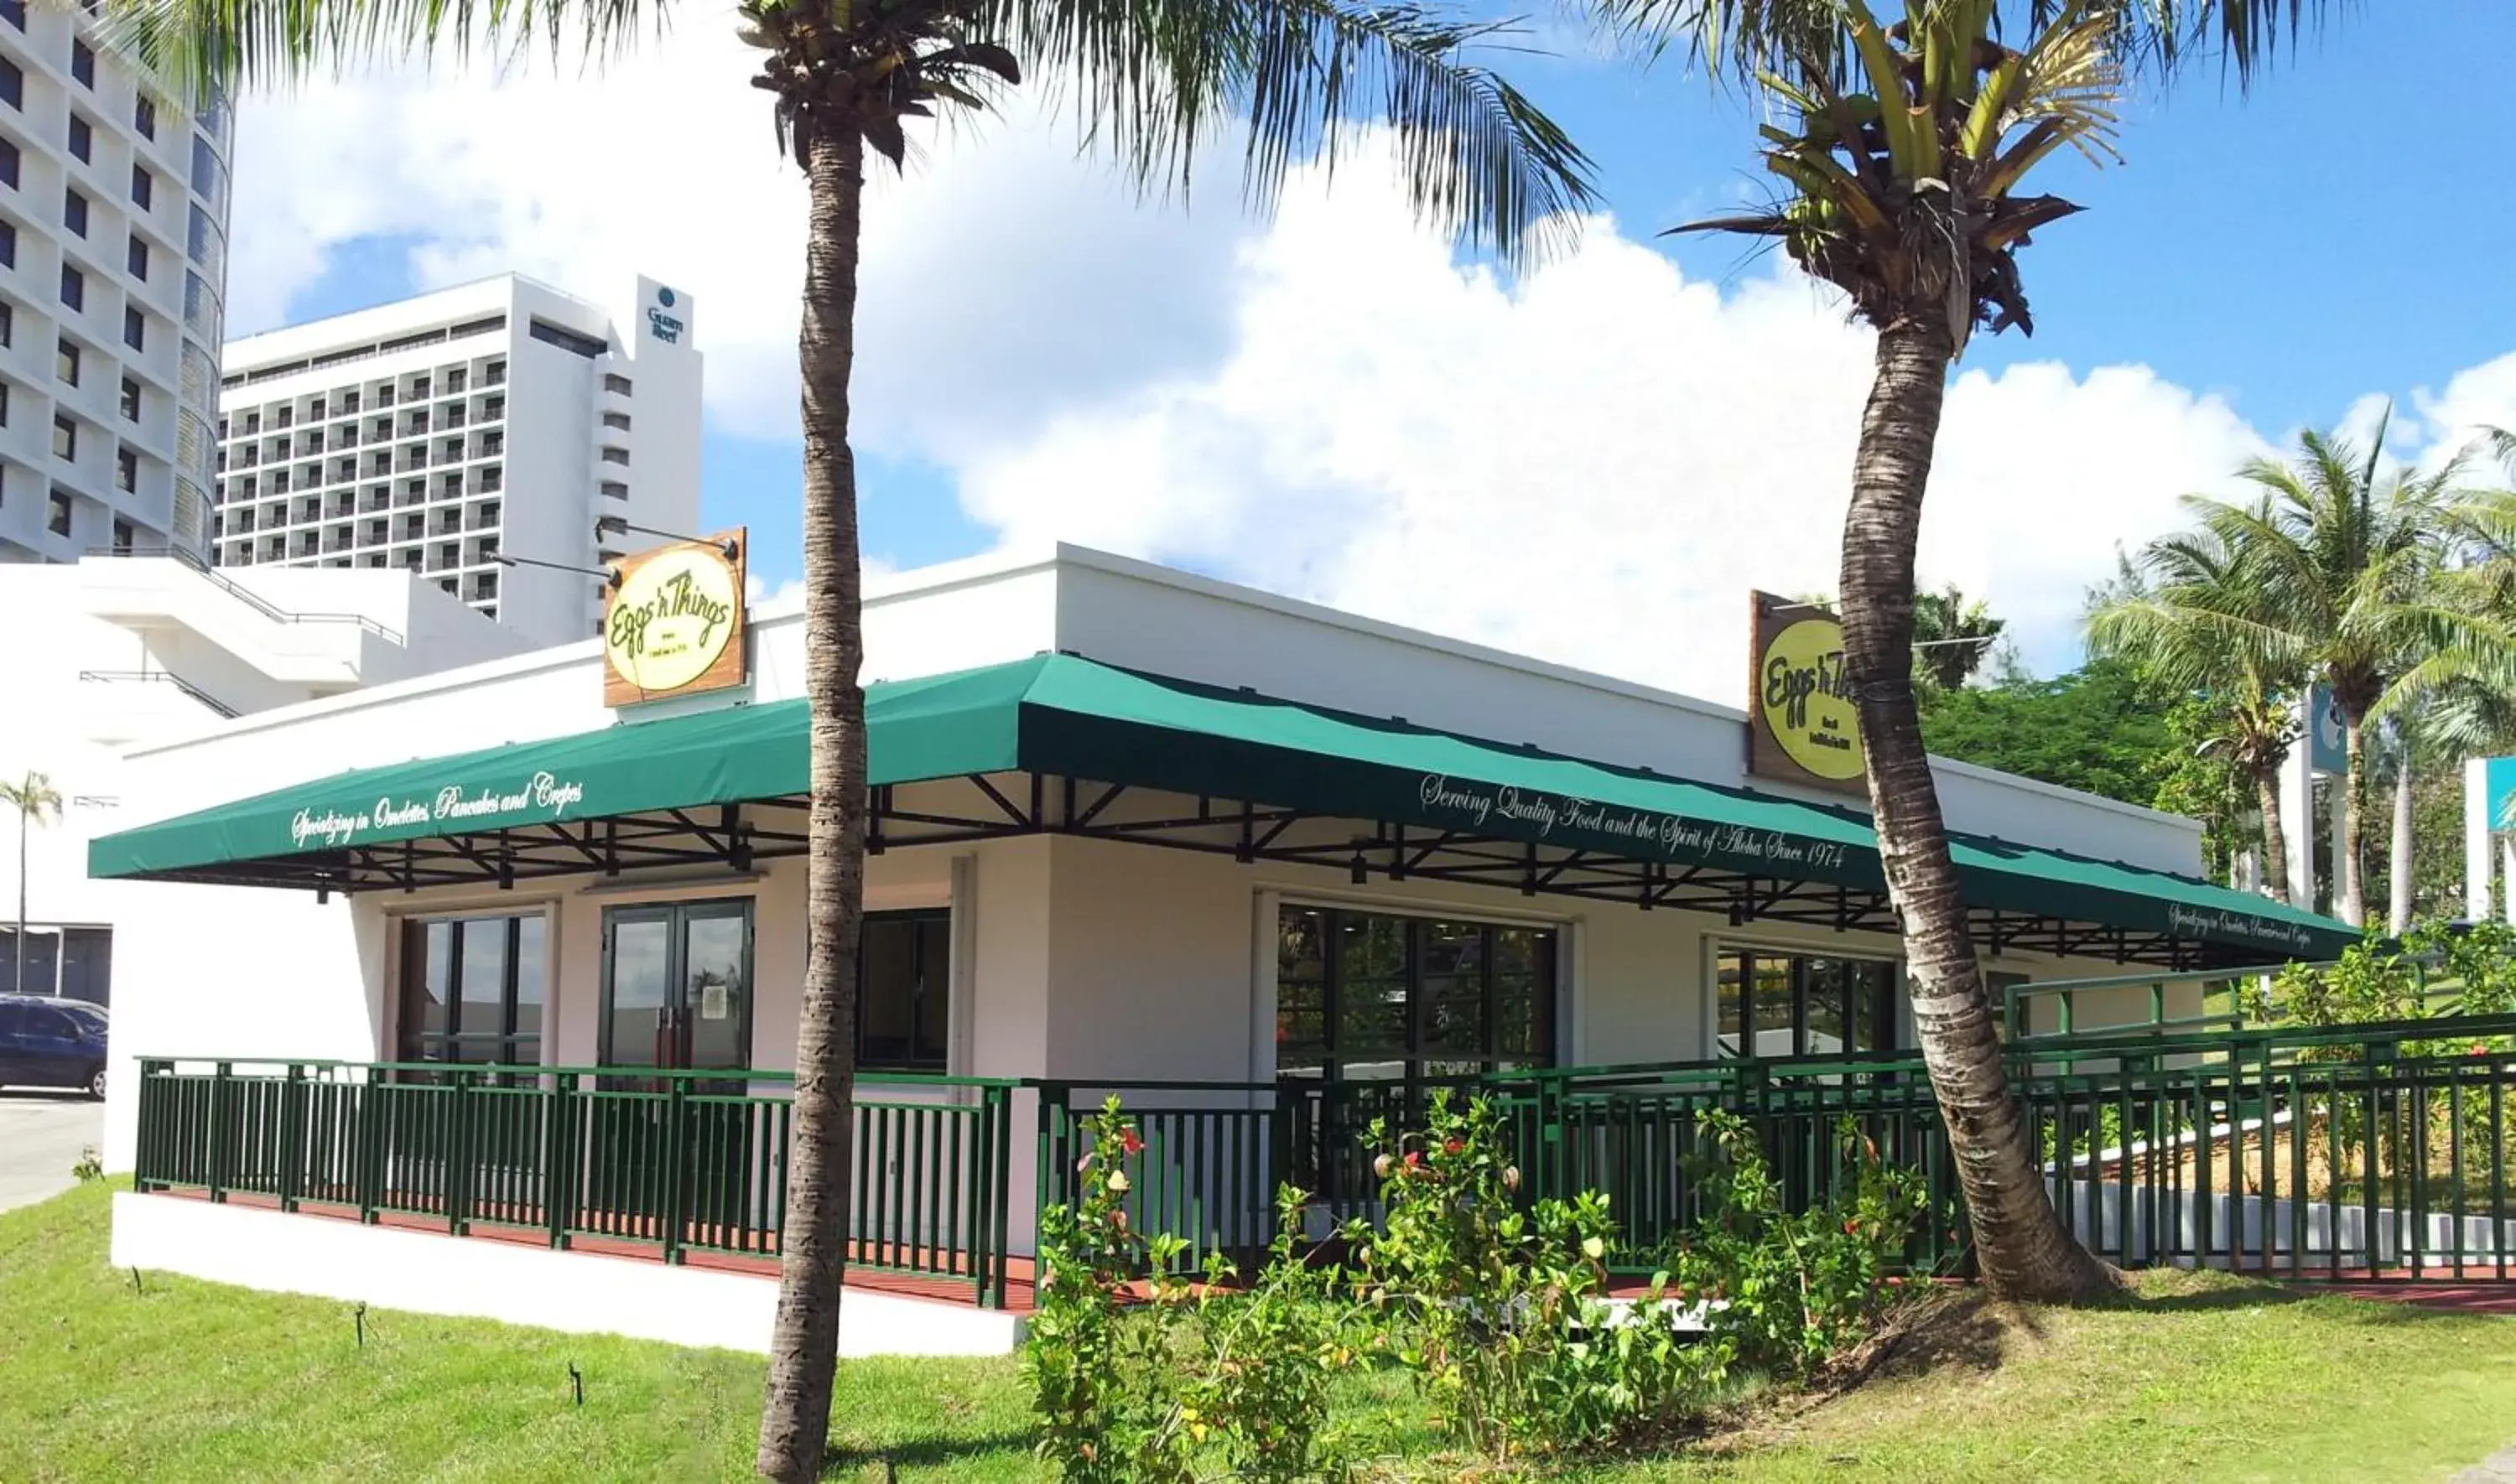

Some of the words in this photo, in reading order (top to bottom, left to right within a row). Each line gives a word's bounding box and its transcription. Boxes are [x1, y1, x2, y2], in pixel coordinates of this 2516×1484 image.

[647, 307, 684, 333] Guam
[611, 600, 654, 660] Eggs
[667, 568, 730, 649] Things
[1765, 656, 1816, 730] Eggs
[356, 811, 370, 830] in
[501, 781, 533, 812] and
[533, 771, 584, 817] Crepes
[1420, 774, 1491, 827] Serving
[1495, 784, 1556, 838] Quality
[1558, 797, 1606, 832] Food
[1604, 812, 1637, 836] and
[1636, 814, 1657, 839] the
[1660, 816, 1702, 856] Spirit
[1702, 825, 1719, 859] of
[1718, 823, 1762, 857] Aloha
[1765, 831, 1803, 864] Since
[1807, 842, 1848, 868] 1974
